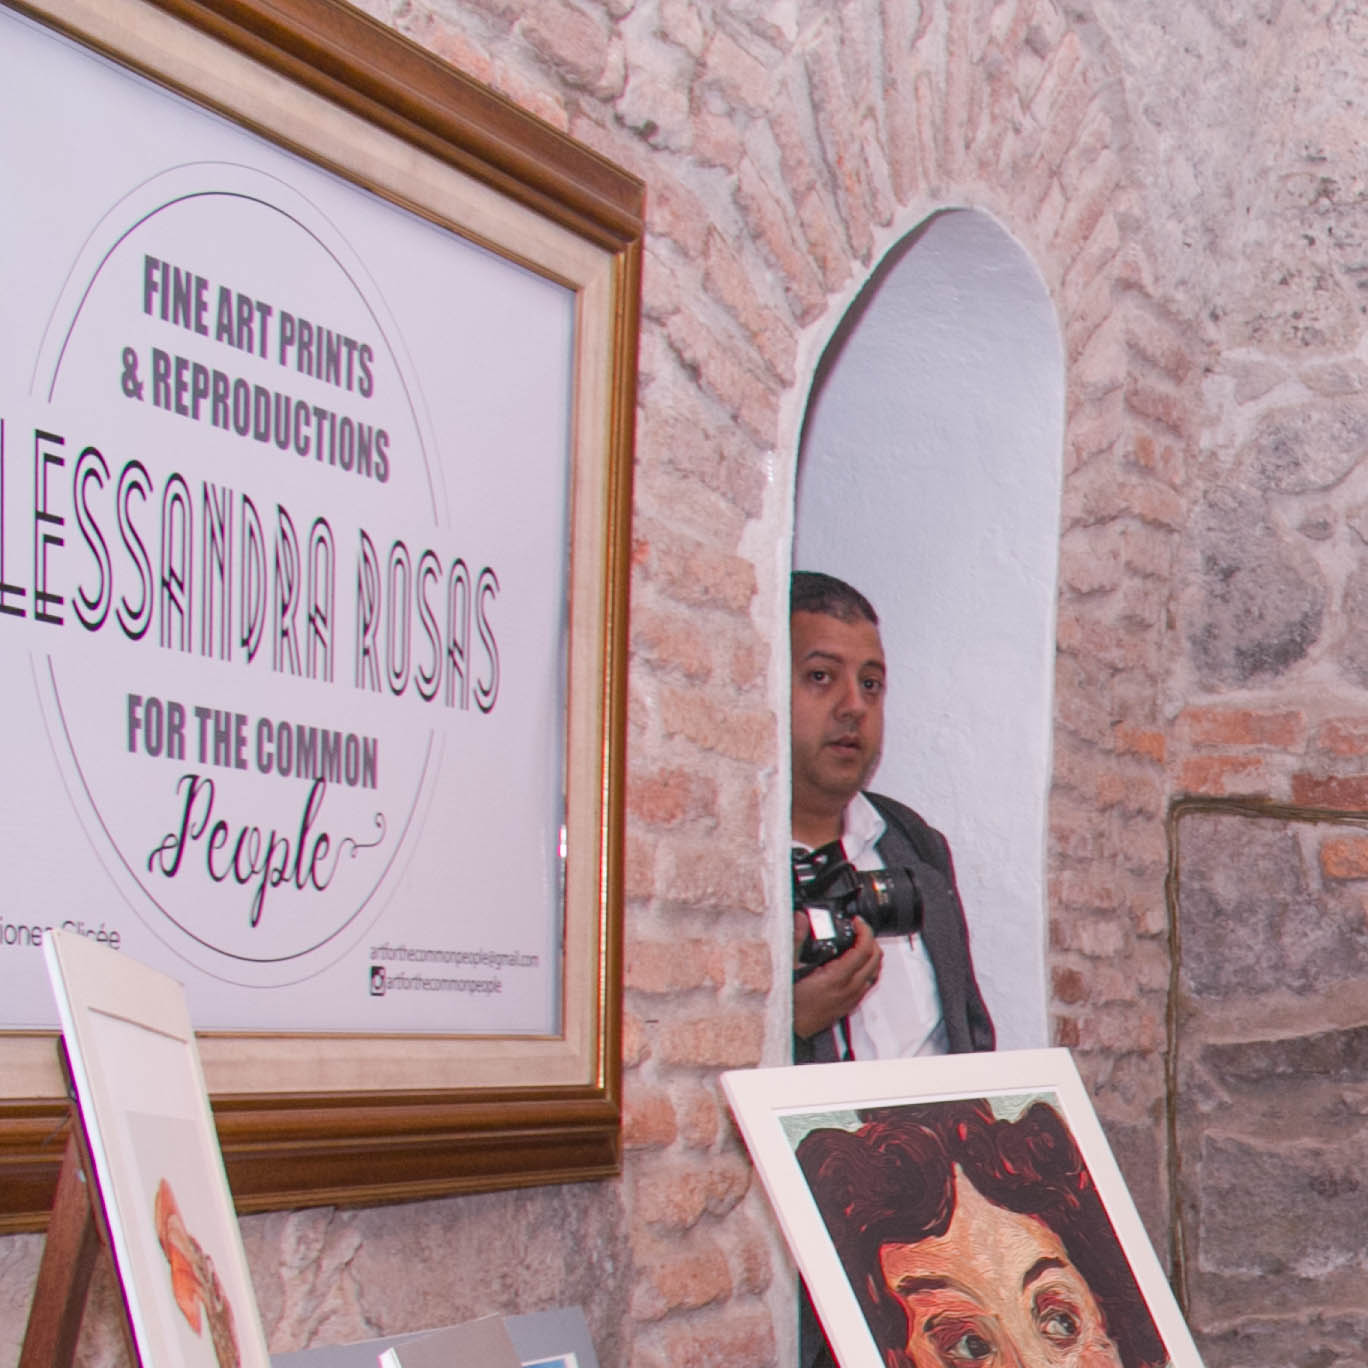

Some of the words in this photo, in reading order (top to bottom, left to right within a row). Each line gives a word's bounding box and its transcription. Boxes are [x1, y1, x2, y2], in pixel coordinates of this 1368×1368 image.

[143, 253, 209, 337] FINE
[215, 285, 273, 360] ART
[279, 309, 374, 399] PRINTS
[121, 346, 145, 402] &
[152, 346, 390, 484] REPRODUCTIONS
[355, 528, 500, 714] ROSAS
[127, 693, 187, 761] FOR
[194, 705, 248, 771] THE
[256, 716, 378, 790] COMMON
[147, 773, 386, 928] People
[0, 915, 53, 946] ione
